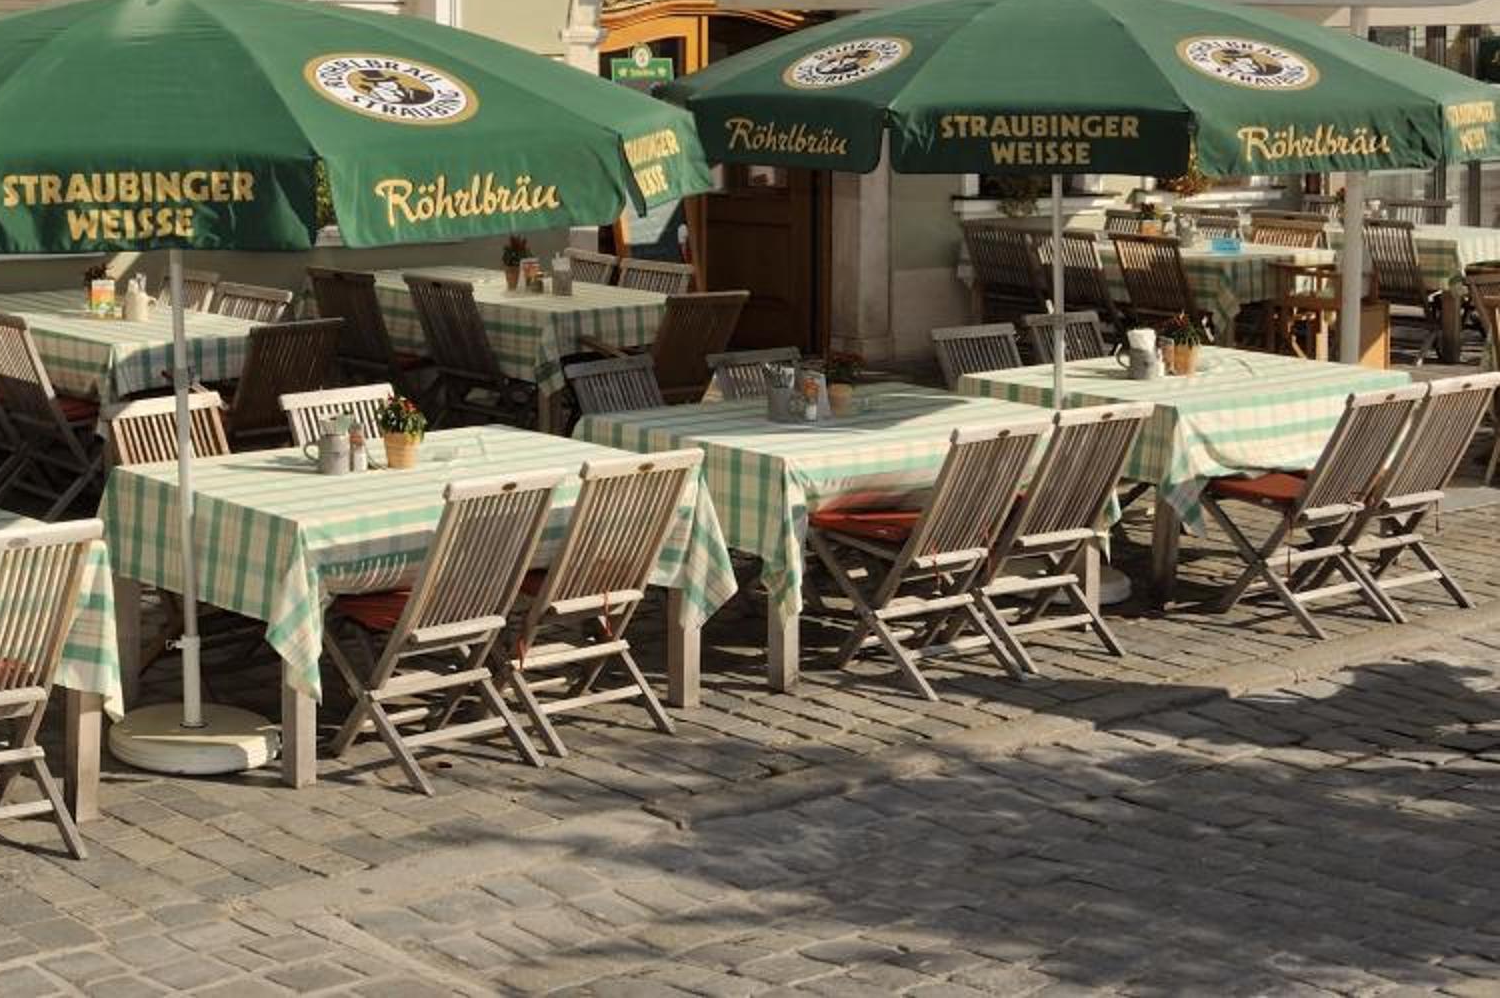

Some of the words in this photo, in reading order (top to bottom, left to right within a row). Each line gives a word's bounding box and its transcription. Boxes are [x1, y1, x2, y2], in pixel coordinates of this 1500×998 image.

[724, 117, 848, 155] Röhrlbräu
[940, 114, 1140, 139] STRAUBINGER
[1237, 123, 1391, 162] Röhrlbräu
[990, 141, 1092, 165] WEISSE
[2, 170, 256, 207] STRAUBINGER
[373, 171, 561, 227] Röhrlbräu
[66, 207, 196, 241] WEISSE
